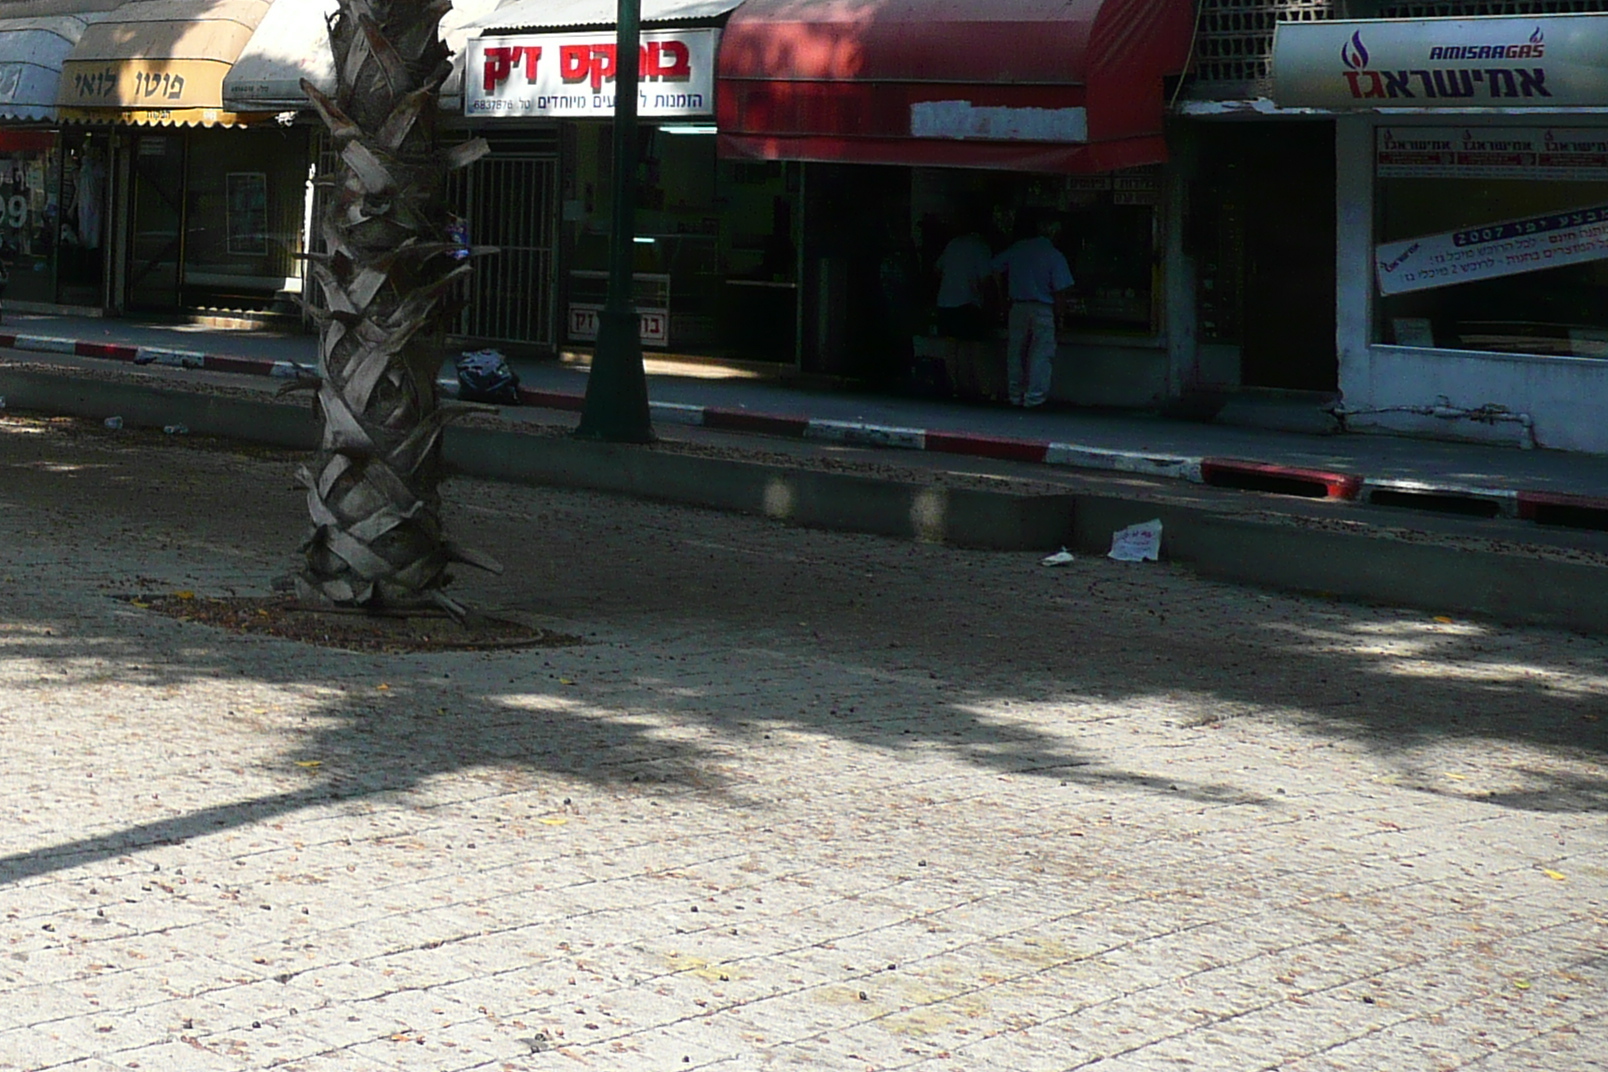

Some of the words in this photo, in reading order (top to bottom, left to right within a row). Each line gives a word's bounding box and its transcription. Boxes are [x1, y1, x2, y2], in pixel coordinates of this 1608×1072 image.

[1429, 44, 1546, 60] AMISRAGAS
[559, 40, 691, 90] בוקס
[75, 67, 117, 98] לואי
[135, 71, 185, 100] פוטו
[1342, 68, 1553, 99] אמישראגז
[537, 96, 586, 109] מיוחדים
[654, 94, 703, 108] הזמנות
[1544, 141, 1608, 153] מישראגז
[1457, 227, 1504, 245] 2007
